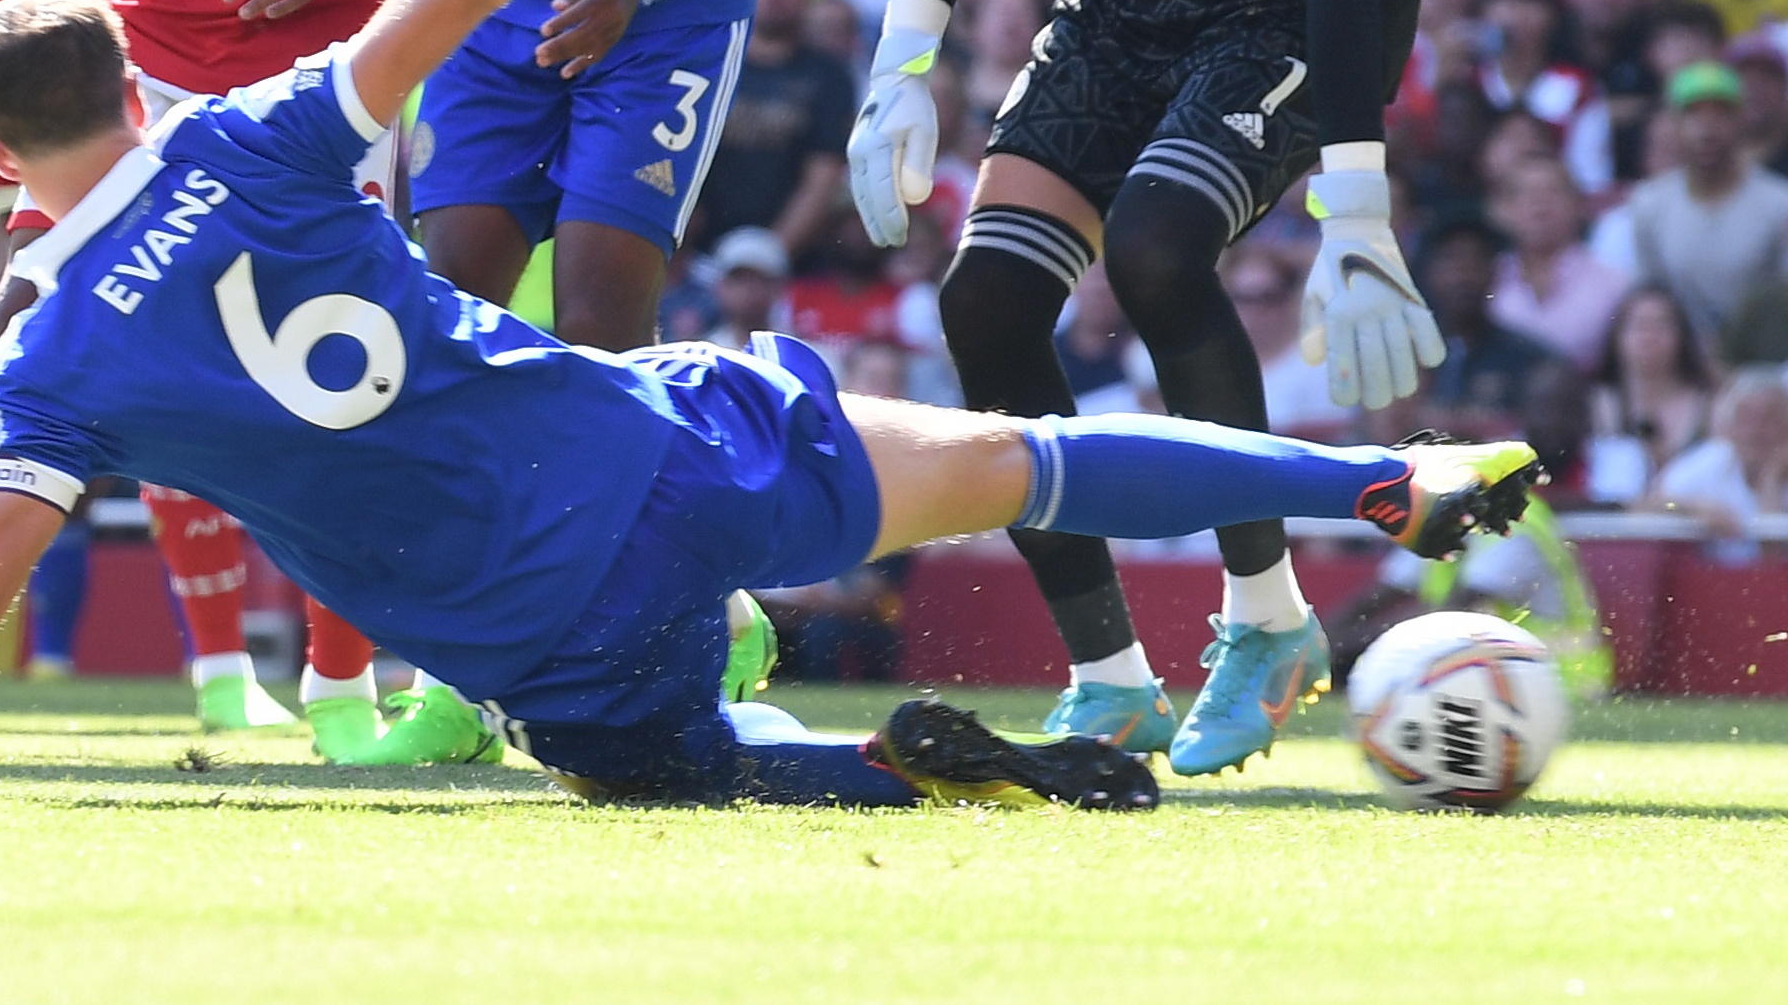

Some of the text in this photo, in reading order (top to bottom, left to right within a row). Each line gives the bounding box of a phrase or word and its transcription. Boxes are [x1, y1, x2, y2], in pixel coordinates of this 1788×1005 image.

[652, 69, 711, 152] 3
[1259, 56, 1308, 116] 1
[92, 169, 231, 315] EVANS
[214, 251, 407, 430] 6
[1435, 693, 1485, 779] NIKE
